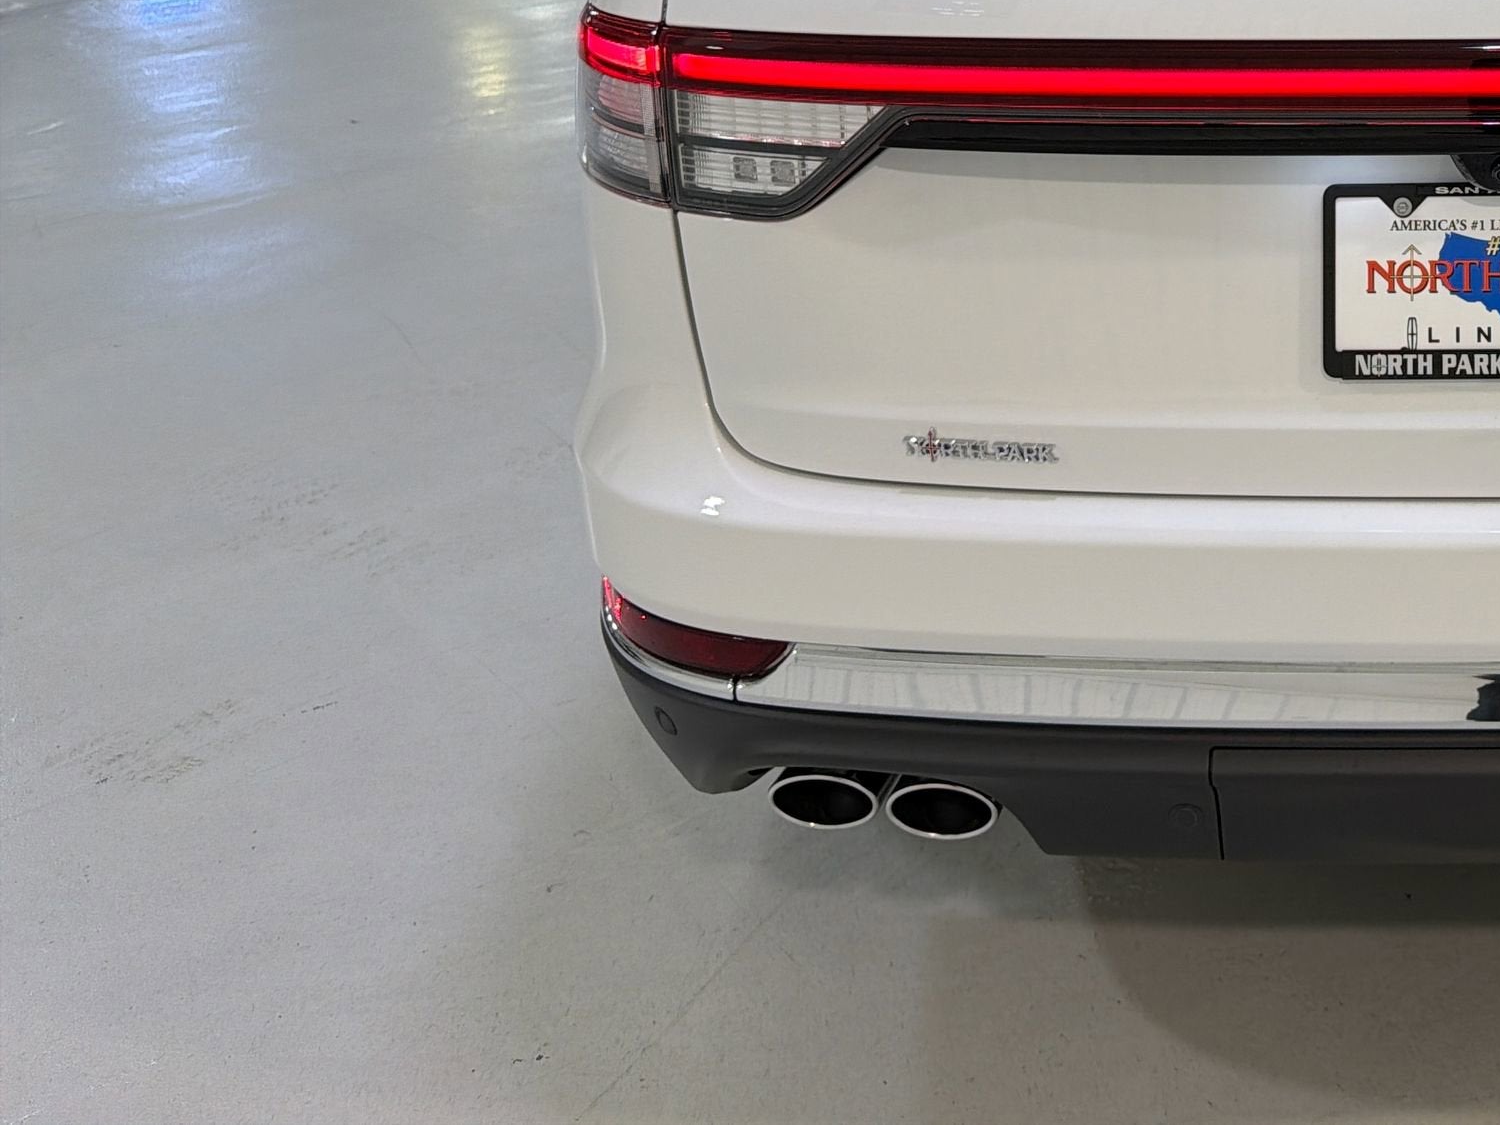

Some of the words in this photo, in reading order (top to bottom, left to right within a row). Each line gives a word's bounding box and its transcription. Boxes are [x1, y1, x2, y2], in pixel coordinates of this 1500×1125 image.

[1435, 186, 1479, 195] SAN
[1390, 219, 1467, 232] AMERICA'S
[1471, 219, 1485, 231] #1
[1355, 353, 1433, 376] NORTH
[993, 441, 1059, 463] PARK
